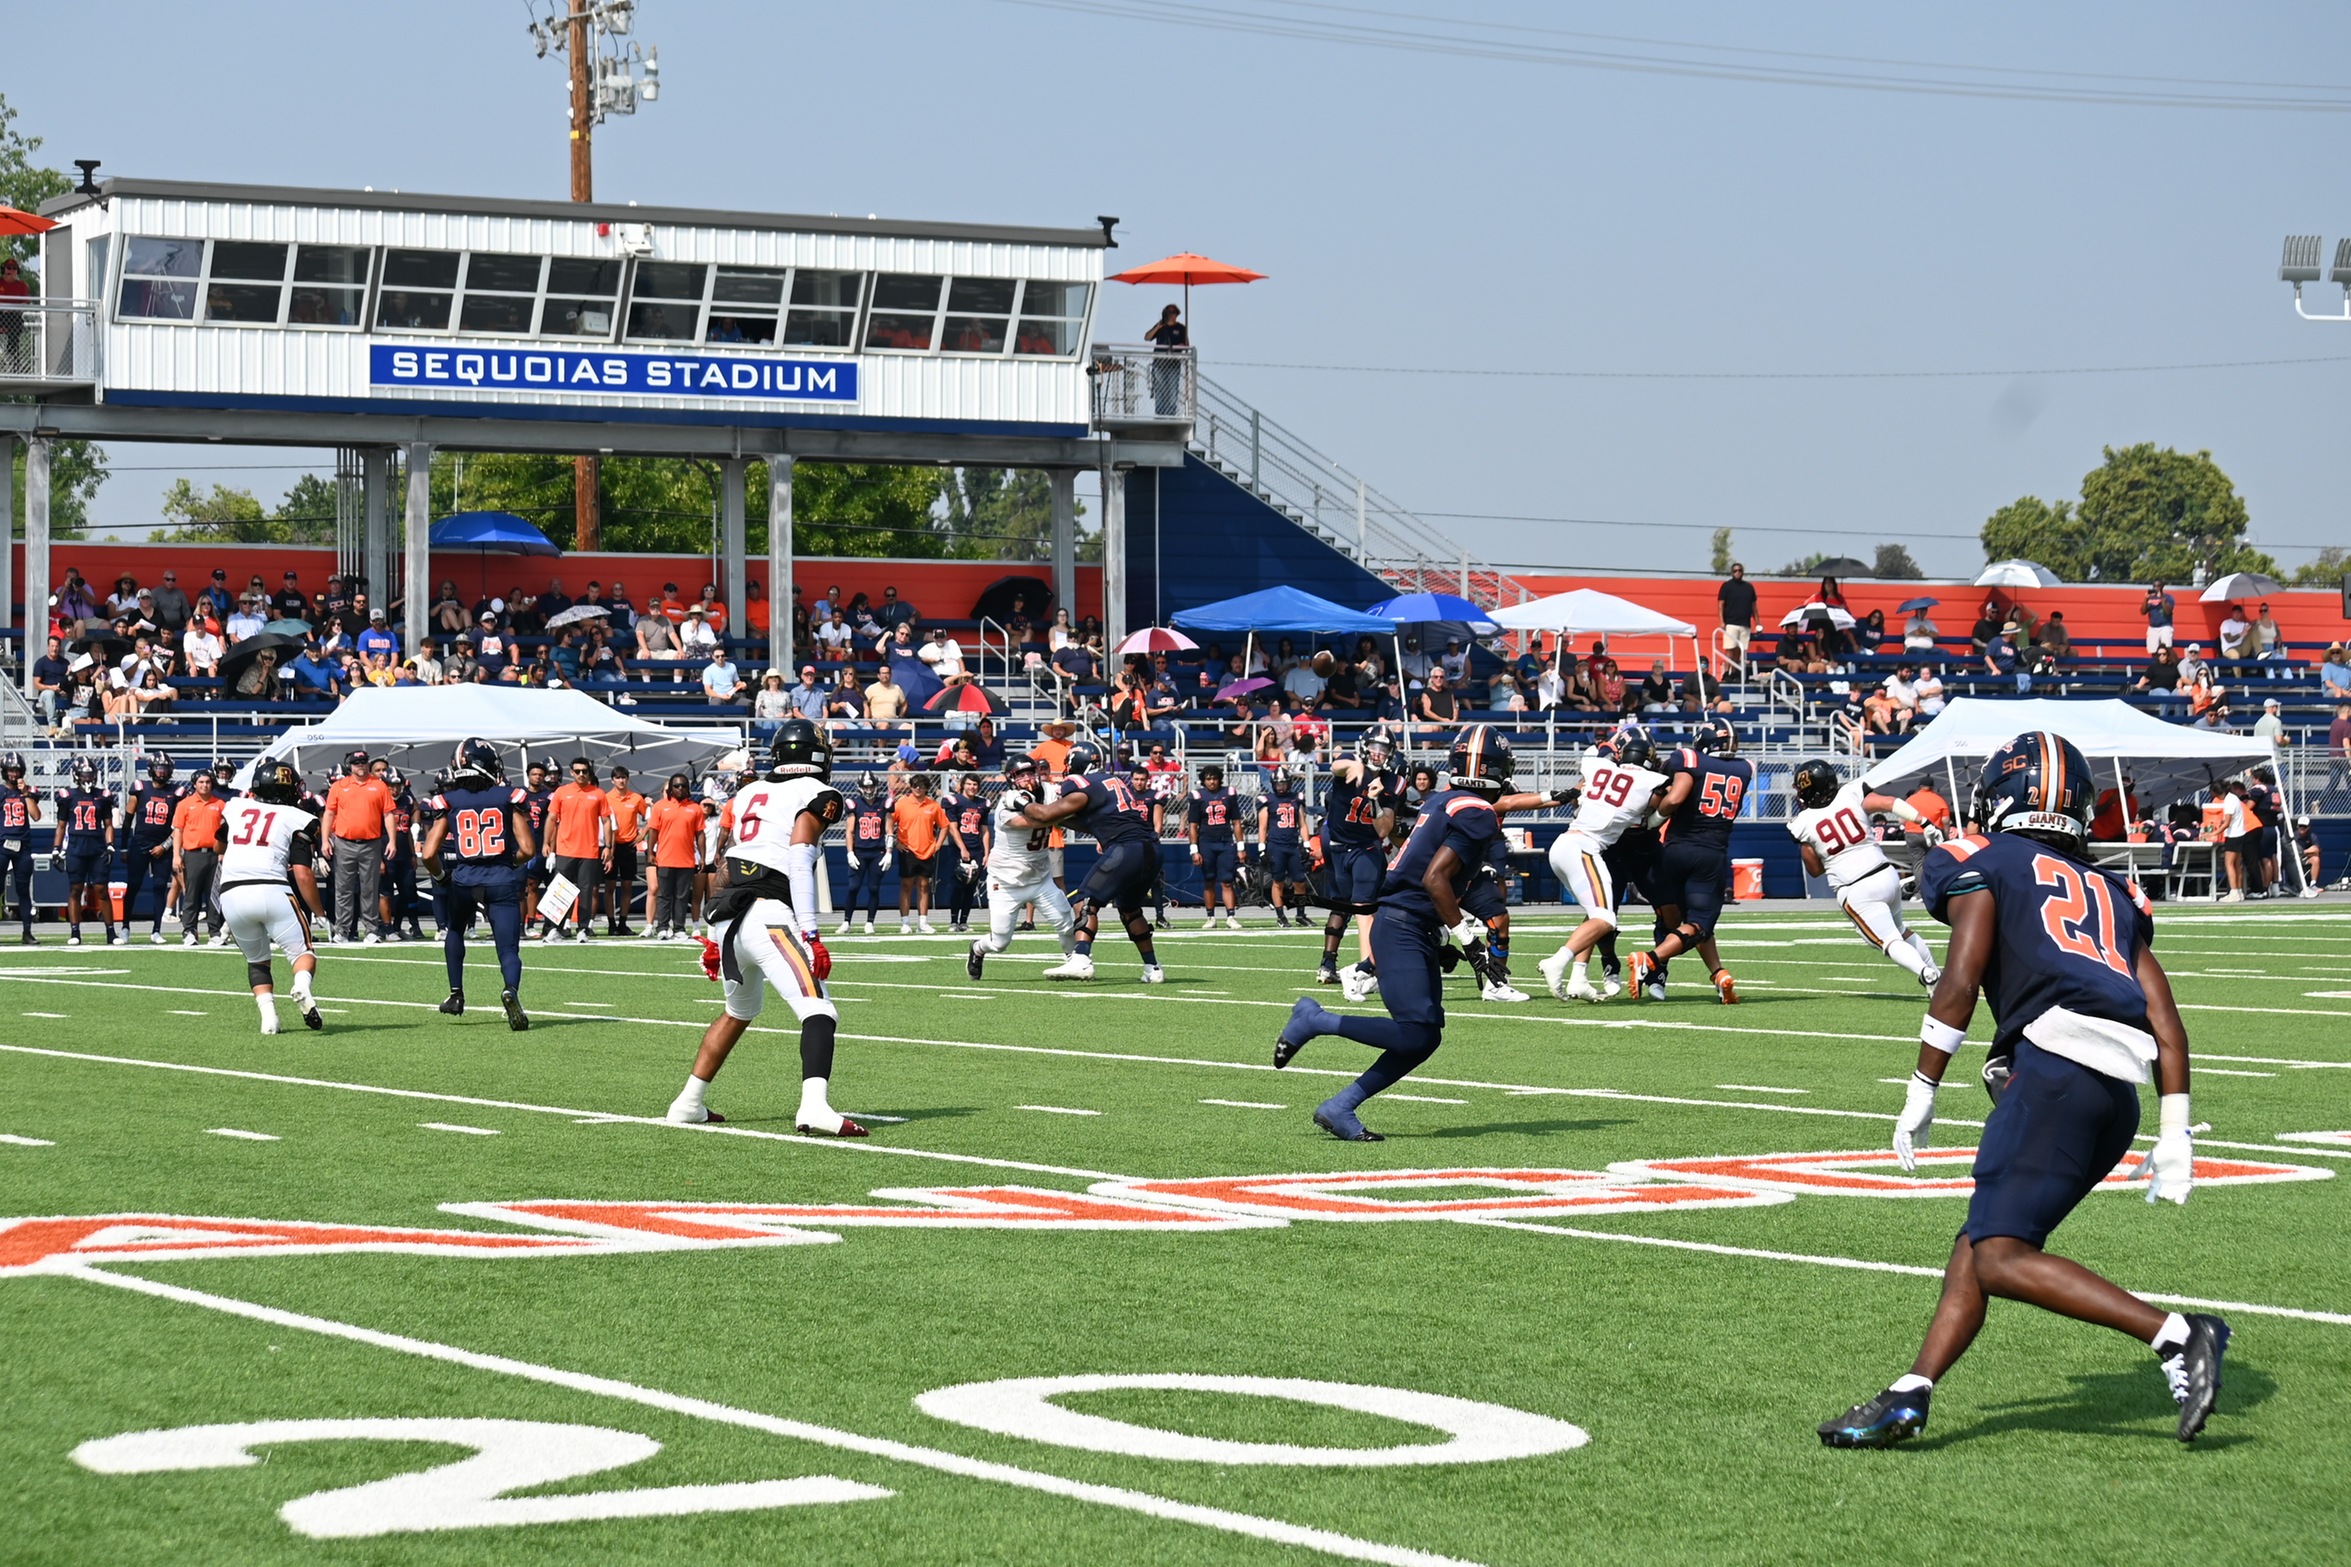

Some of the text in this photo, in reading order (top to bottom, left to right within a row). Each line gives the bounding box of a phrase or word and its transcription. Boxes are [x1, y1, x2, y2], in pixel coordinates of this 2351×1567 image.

[391, 349, 839, 393] SEQUOIAS STADIUM
[780, 766, 811, 774] Riddell
[2002, 754, 2027, 774] SC
[1457, 777, 1487, 788] GIANTS
[1587, 768, 1634, 807] 99
[1699, 772, 1743, 820] 59
[2027, 786, 2072, 808] 2 1
[3, 802, 26, 828] 19
[73, 805, 97, 830] 14
[145, 801, 168, 825] 18
[740, 793, 769, 843] 6
[960, 811, 982, 836] 90
[1205, 804, 1227, 826] 12
[1276, 806, 1295, 828] 31
[2029, 811, 2068, 827] GIANTS
[232, 808, 277, 847] 31
[455, 808, 506, 857] 82
[858, 816, 882, 840] 80
[1816, 807, 1866, 856] 90
[2031, 853, 2132, 979] 21
